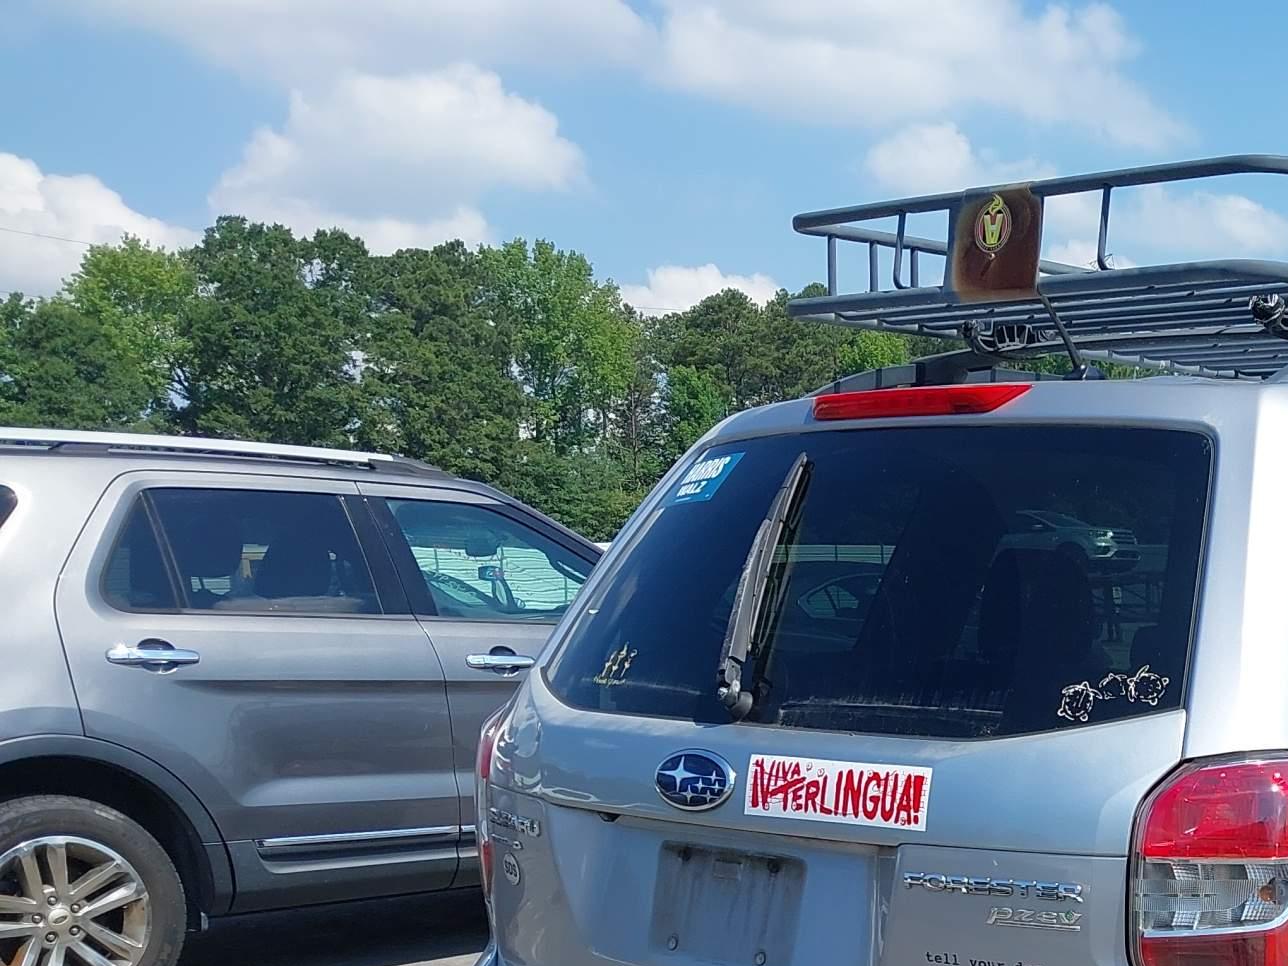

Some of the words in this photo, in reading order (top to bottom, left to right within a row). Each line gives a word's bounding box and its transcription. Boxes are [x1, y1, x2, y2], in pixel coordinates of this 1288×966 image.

[681, 456, 732, 486] HARRIS
[676, 480, 708, 497] WALZ
[903, 871, 1085, 904] FORESTER
[925, 951, 960, 966] tell
